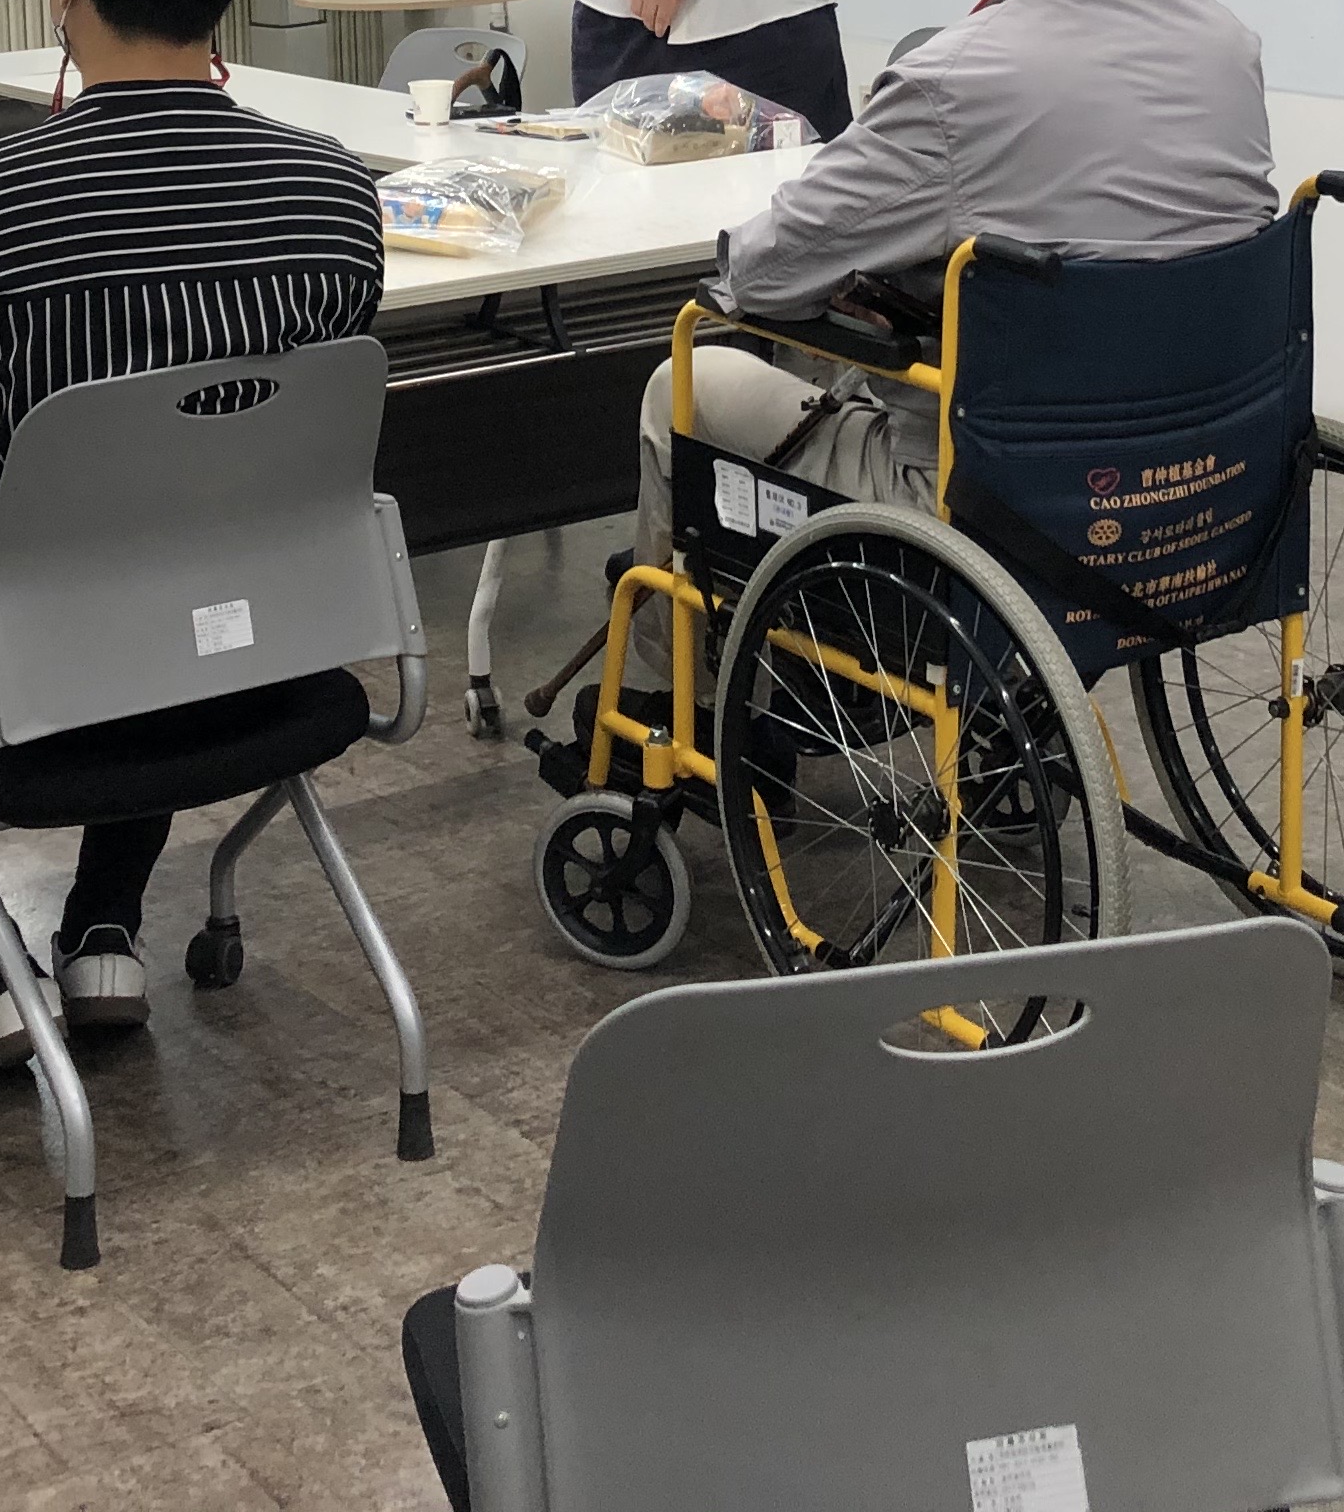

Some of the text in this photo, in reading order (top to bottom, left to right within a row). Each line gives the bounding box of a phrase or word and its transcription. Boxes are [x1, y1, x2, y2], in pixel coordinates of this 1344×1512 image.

[1090, 495, 1121, 510] CAO
[1123, 485, 1188, 508] ZHONGZHI
[1078, 552, 1126, 567] OTARY
[1127, 546, 1162, 563] CLUB
[1162, 541, 1179, 556] OF
